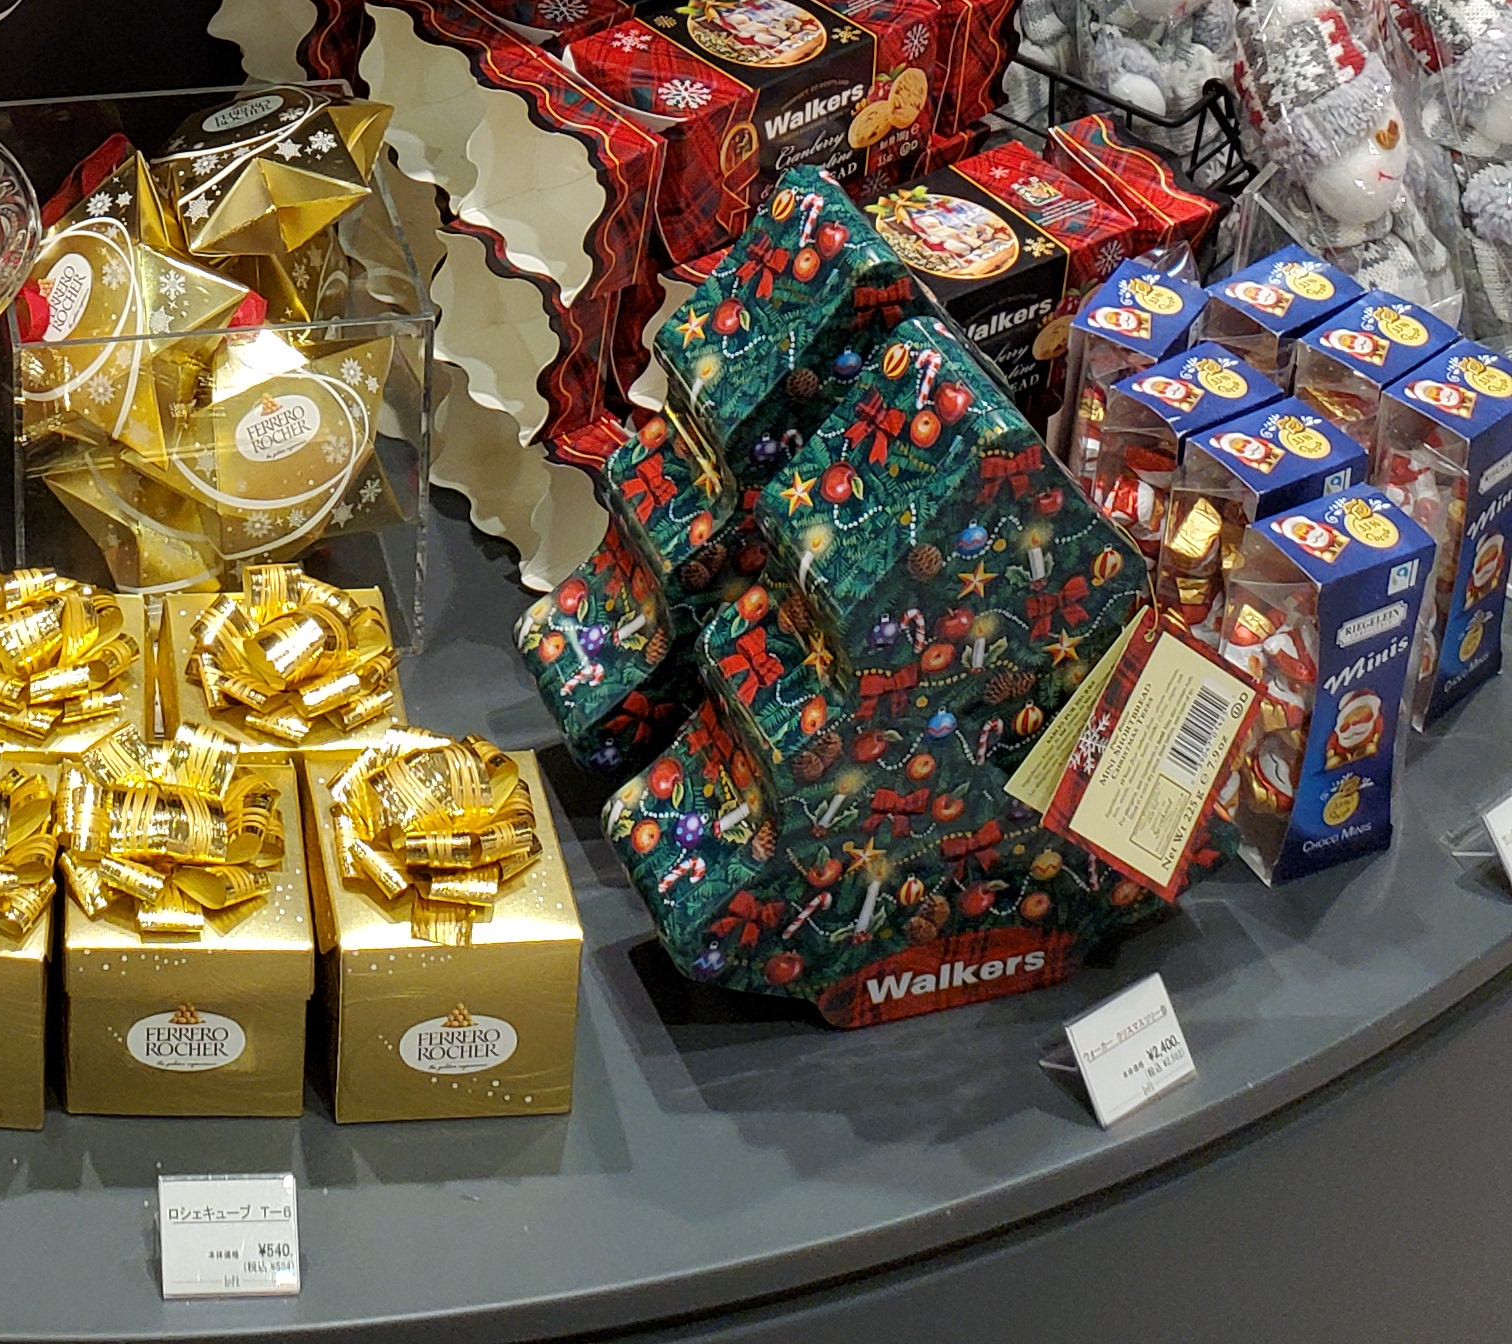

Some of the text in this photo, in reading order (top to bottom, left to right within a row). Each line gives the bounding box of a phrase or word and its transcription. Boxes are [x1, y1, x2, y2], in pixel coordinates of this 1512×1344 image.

[764, 83, 865, 141] Walkers
[245, 404, 307, 442] FERRERO
[251, 417, 313, 456] ROCHER
[1323, 634, 1410, 696] Minis
[1099, 682, 1153, 787] MINI SHORTBREAD
[1110, 726, 1140, 781] CHRISTMAS
[1161, 849, 1176, 871] Net
[1183, 799, 1199, 823] 225
[866, 948, 1048, 1005] Walkers
[145, 1025, 231, 1044] FERRERO
[145, 1040, 228, 1059] ROCHER
[415, 1027, 501, 1045] FERRERO
[418, 1042, 500, 1060] ROCHER
[1145, 1034, 1181, 1061] ¥2,400.
[168, 1203, 252, 1221] ロシェキューブ
[257, 1242, 294, 1258] ¥540.
